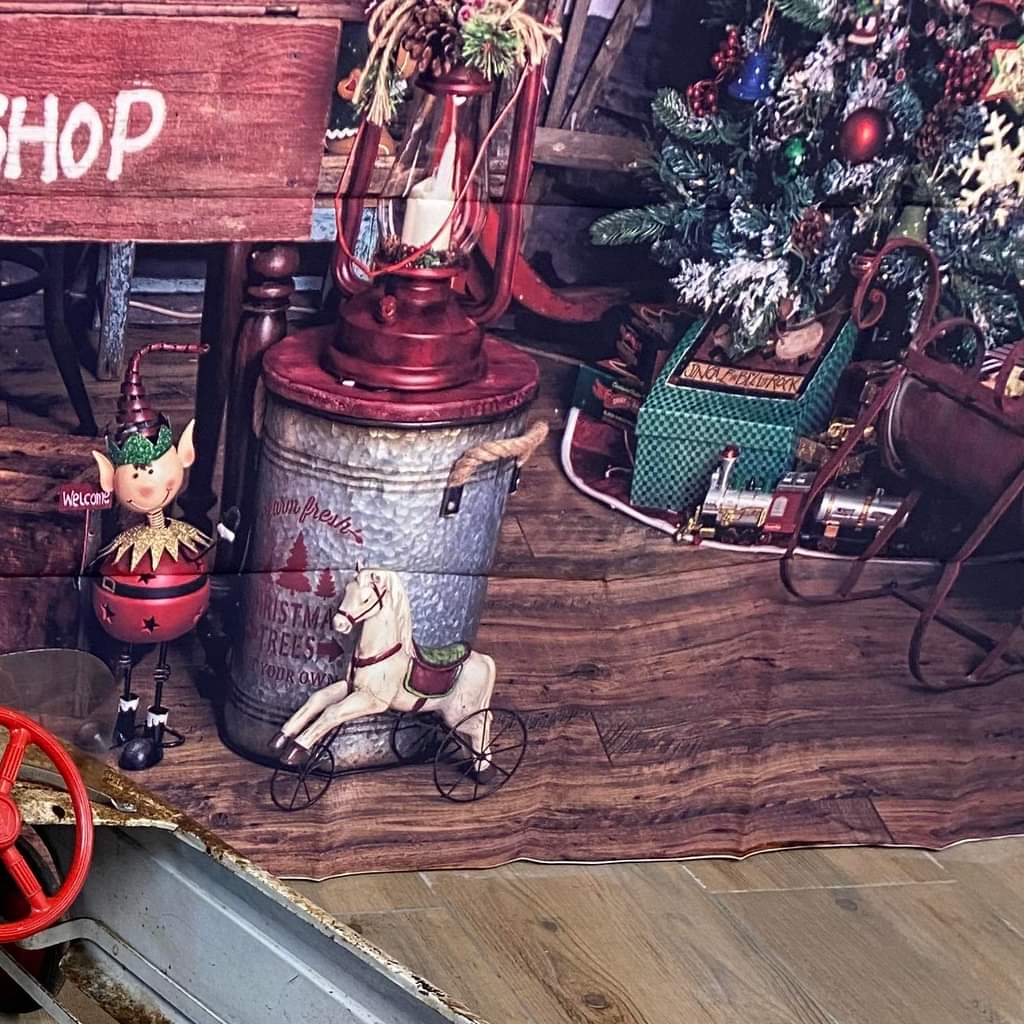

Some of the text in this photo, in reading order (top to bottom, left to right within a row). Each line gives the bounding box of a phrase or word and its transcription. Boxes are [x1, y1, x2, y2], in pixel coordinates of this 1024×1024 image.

[63, 490, 111, 507] Welcome
[298, 495, 363, 545] fresh
[259, 624, 314, 660] TREES
